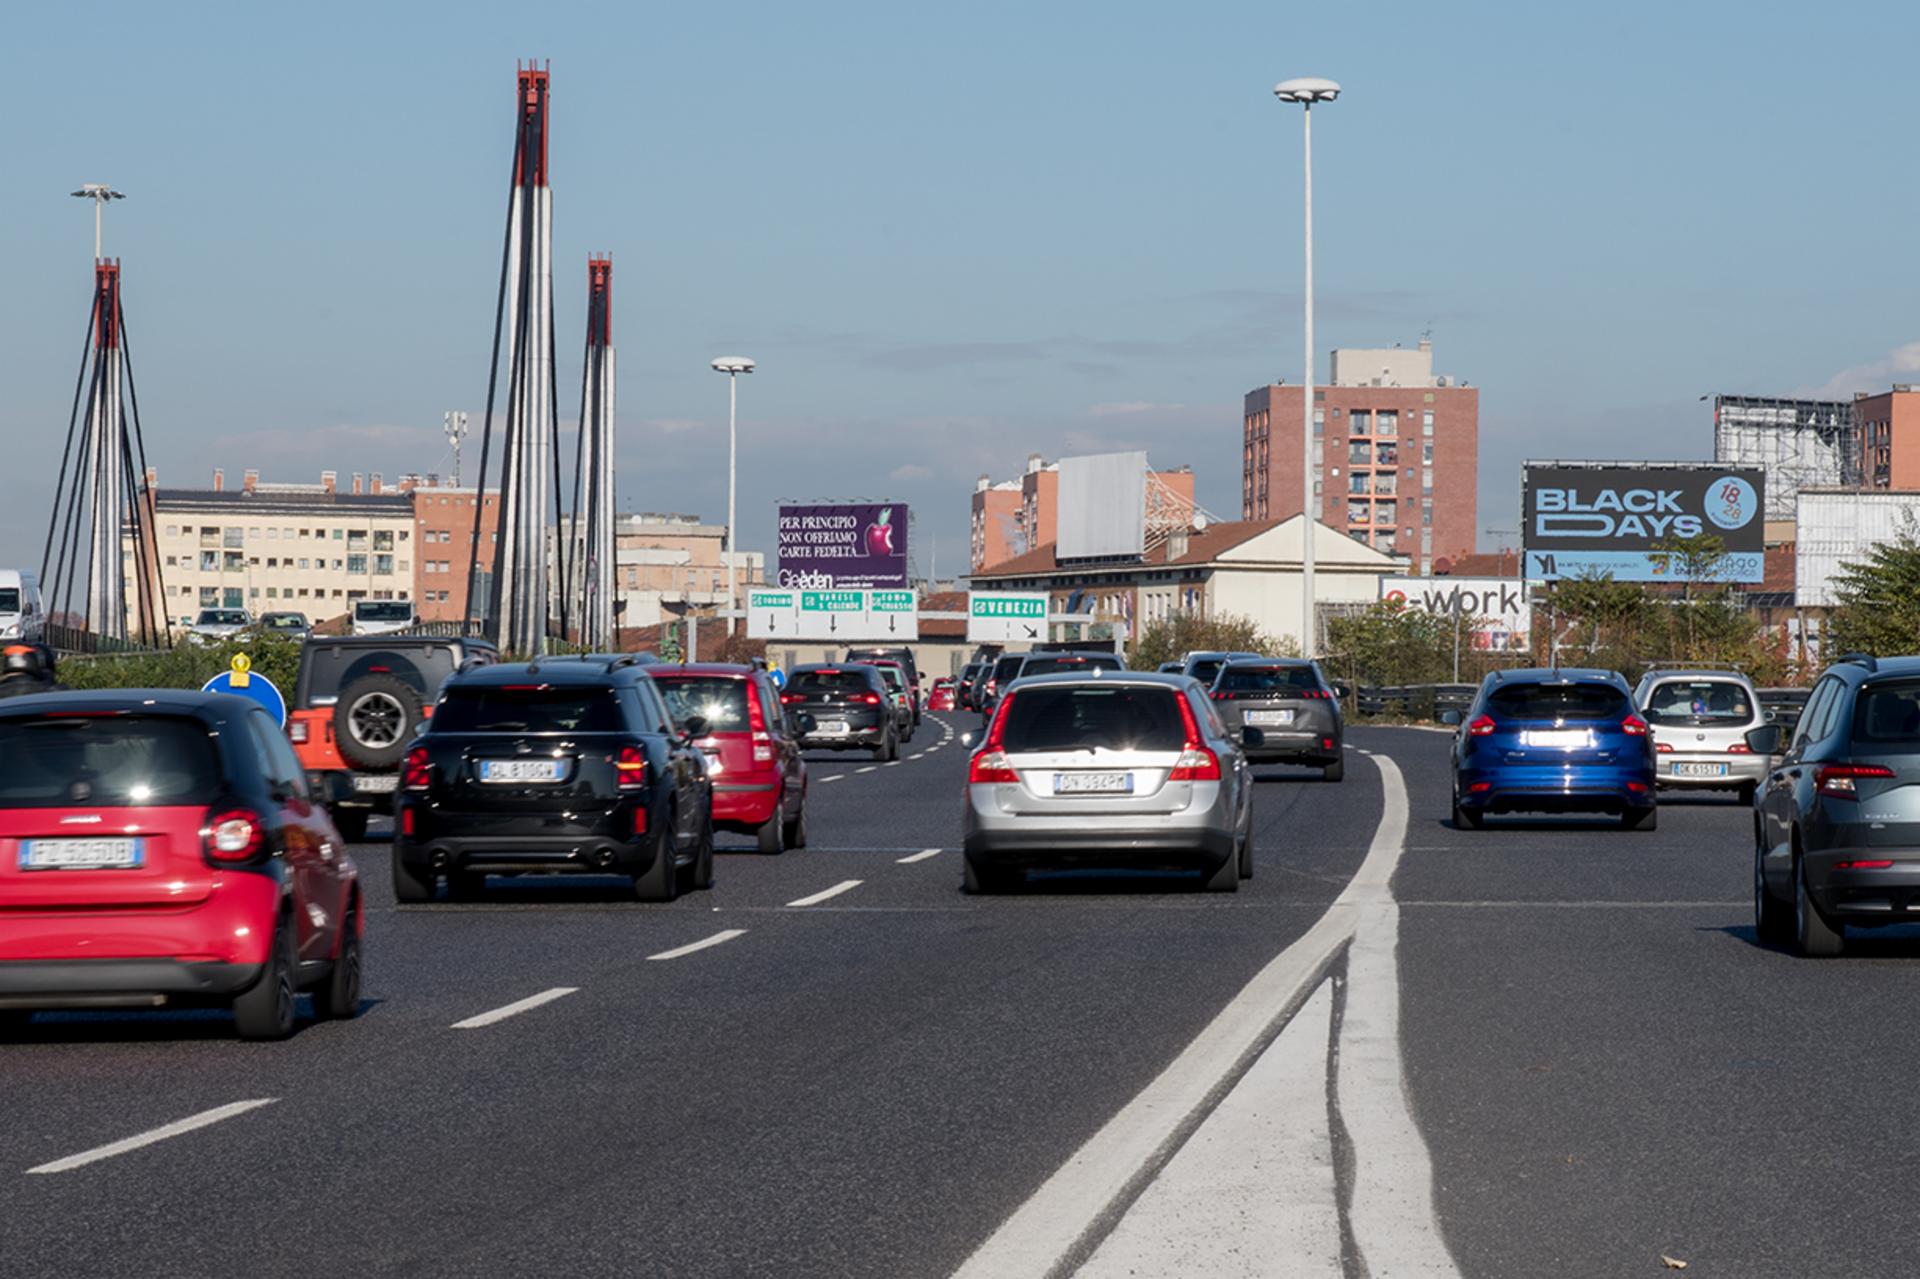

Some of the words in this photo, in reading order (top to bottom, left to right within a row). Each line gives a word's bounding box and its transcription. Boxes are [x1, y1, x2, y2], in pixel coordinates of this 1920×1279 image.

[1535, 489, 1684, 512] BLACK
[1720, 484, 1741, 504] 18
[1723, 504, 1742, 520] 28
[780, 516, 800, 529] PER
[802, 516, 857, 528] PRINCIPIO
[1535, 514, 1702, 538] DAYS
[780, 532, 802, 544] NON
[804, 532, 857, 544] OFFRIAMO
[779, 546, 812, 558] CARTE
[819, 592, 854, 602] VARESE
[881, 592, 907, 601] COMO
[1385, 583, 1519, 614] e-work
[988, 601, 1043, 614] VENEZIA
